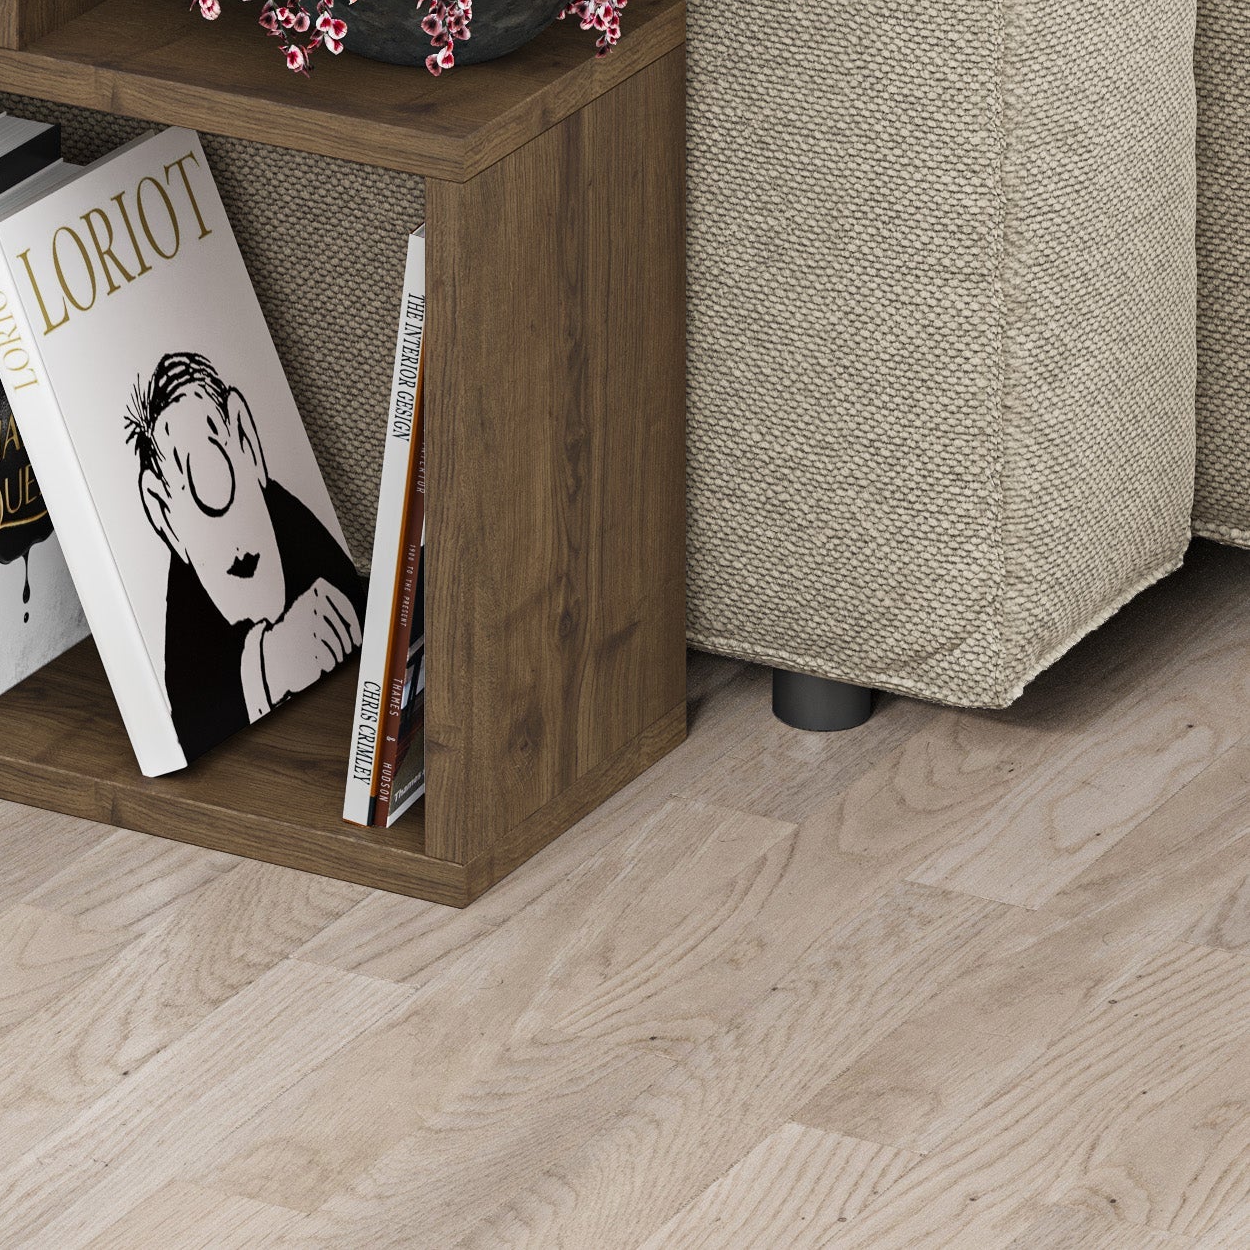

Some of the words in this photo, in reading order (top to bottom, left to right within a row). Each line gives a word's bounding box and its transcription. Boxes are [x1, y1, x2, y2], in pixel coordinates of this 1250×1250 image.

[16, 150, 213, 336] LORIOT
[407, 293, 425, 323] THE
[400, 322, 422, 388] INTERIOR
[404, 577, 412, 591] THE
[401, 596, 410, 627] PRESENT
[362, 681, 381, 722] CHRIS
[390, 678, 403, 717] THAMES
[354, 725, 376, 786] CRIMLEY
[380, 762, 393, 802] HUDSON
